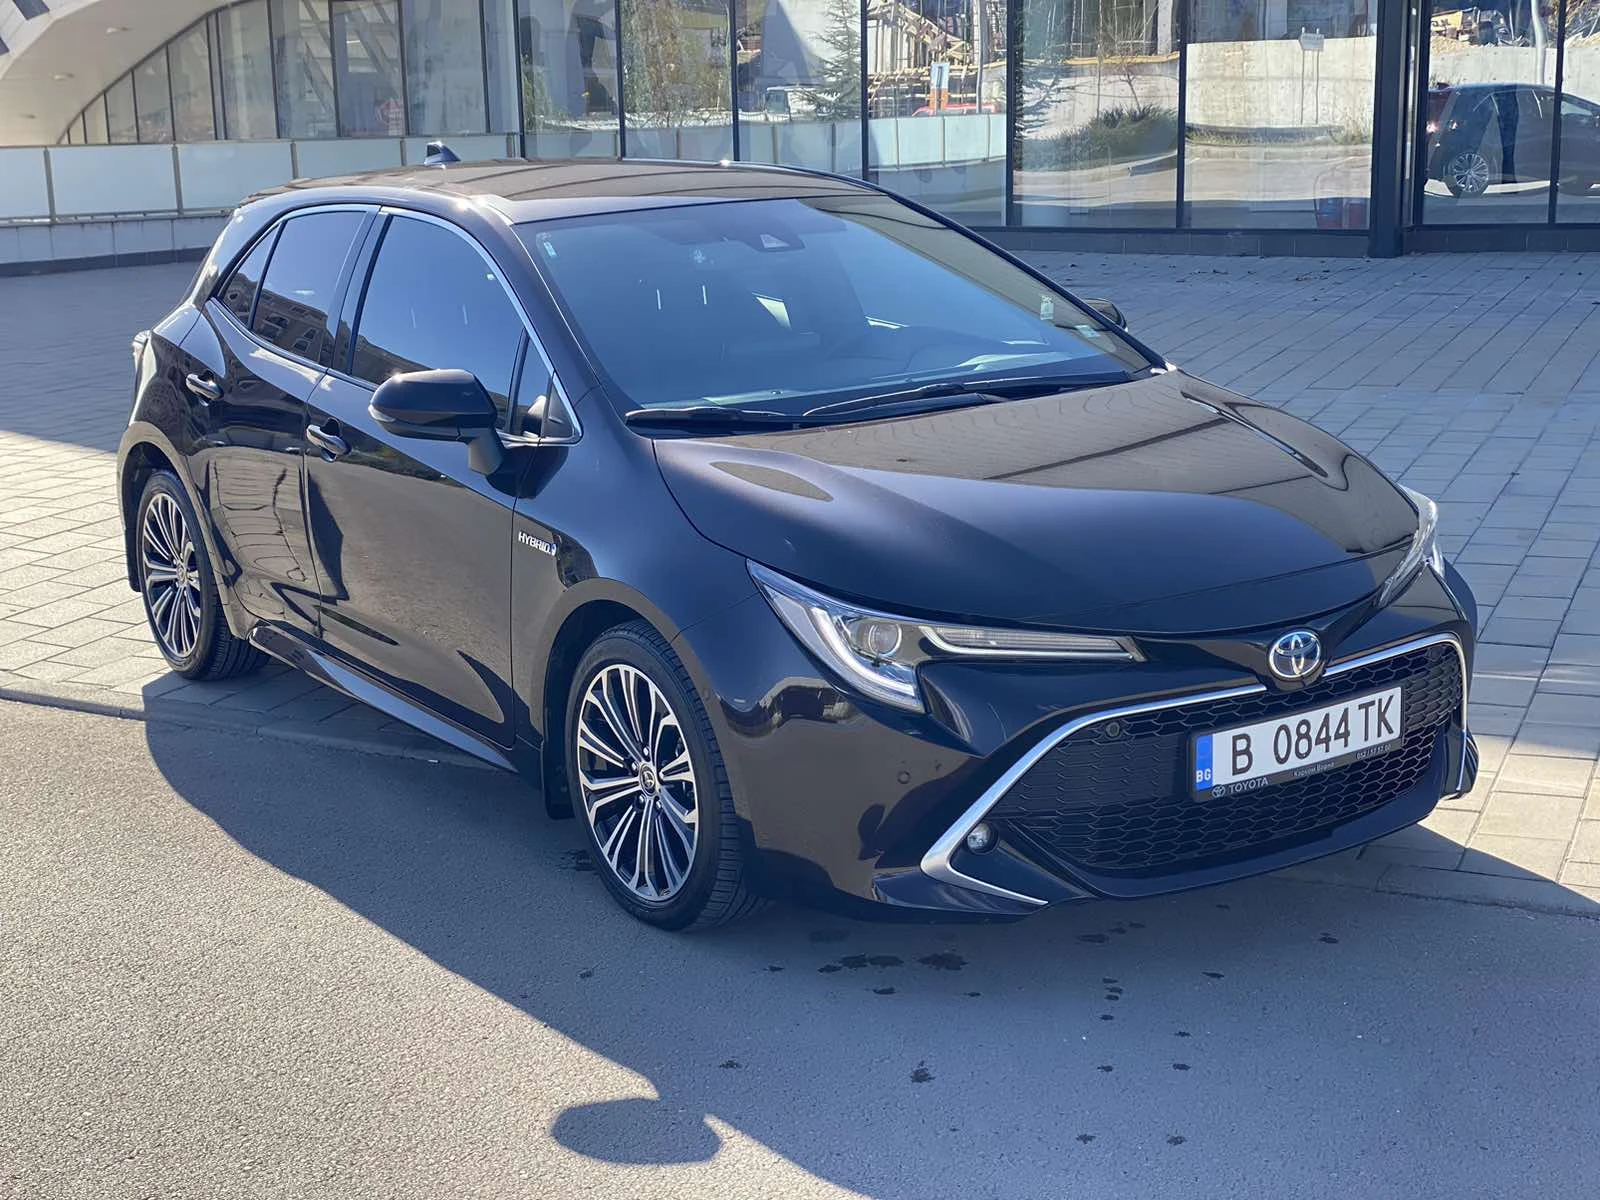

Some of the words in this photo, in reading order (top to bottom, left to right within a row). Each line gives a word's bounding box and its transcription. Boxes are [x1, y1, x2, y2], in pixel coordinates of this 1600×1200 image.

[518, 531, 551, 555] HYBRID
[1231, 733, 1253, 776] B
[1273, 708, 1350, 765] 0844
[1358, 694, 1395, 742] TK
[1195, 768, 1212, 783] BG
[1229, 777, 1269, 794] TOYOTA
